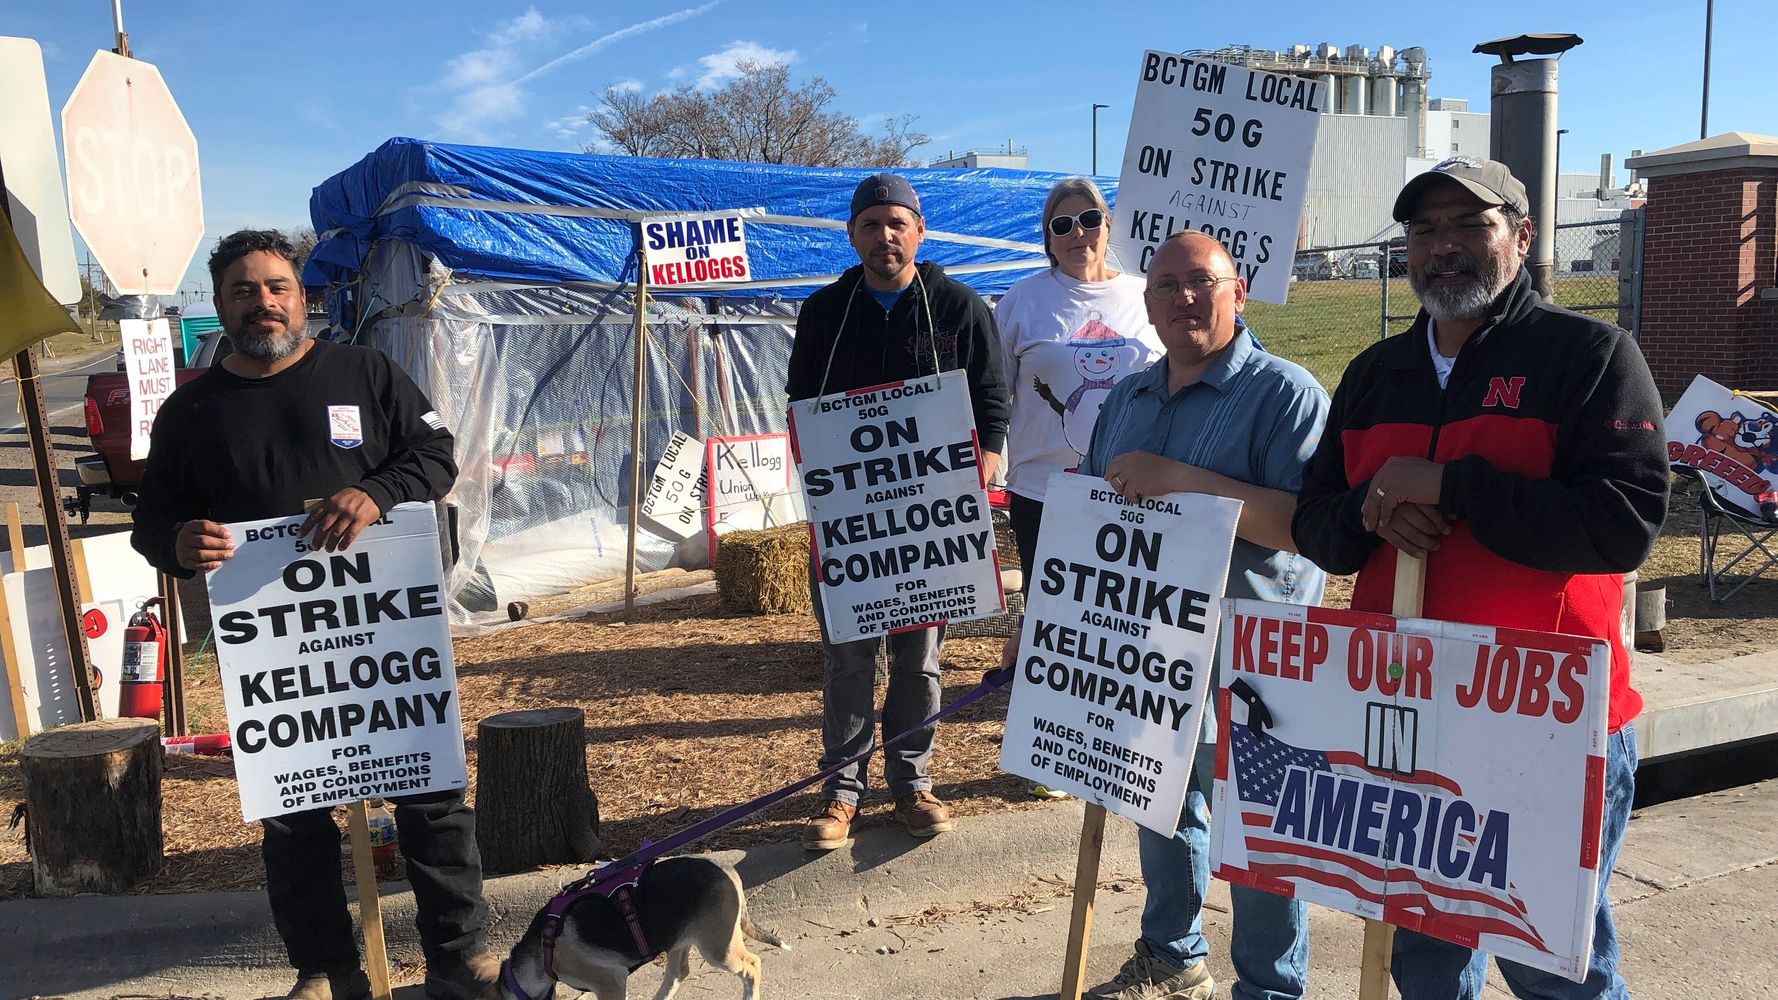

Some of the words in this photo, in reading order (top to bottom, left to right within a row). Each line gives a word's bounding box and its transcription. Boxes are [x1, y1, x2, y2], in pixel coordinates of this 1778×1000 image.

[1144, 52, 1226, 94] BCTGM
[1246, 72, 1318, 112] LOCAL
[75, 126, 189, 221] STOP
[1138, 146, 1172, 178] ON
[1190, 156, 1286, 201] STRIKE
[1169, 190, 1256, 220] AGAINST
[646, 218, 740, 250] SHAME
[686, 246, 710, 260] ON
[652, 256, 746, 285] KELLOGGS
[132, 338, 167, 355] RIGHT
[138, 357, 170, 375] LANE
[140, 377, 170, 395] MUST
[821, 393, 877, 413] BCTGM
[882, 382, 934, 401] LOCAL
[1482, 377, 1526, 408] N
[858, 406, 889, 420] 50G
[850, 416, 920, 453] ON
[716, 441, 782, 470] Kellogg
[804, 440, 978, 497] STRIKE
[643, 474, 666, 517] BCTGM
[660, 433, 688, 470] LOCAL
[720, 480, 754, 494] Union
[865, 484, 924, 504] AGAINST
[1138, 496, 1182, 516] LOCAL
[678, 506, 695, 524] ON
[822, 494, 980, 548] KELLOGG
[1120, 510, 1144, 524] 50G
[246, 524, 300, 542] BCTG
[1096, 523, 1162, 572] ON
[282, 552, 372, 592] ON
[822, 530, 989, 587] COMPANY
[852, 598, 905, 614] WAGES,
[910, 584, 976, 603] BENEFITS
[896, 579, 928, 592] FOR
[1040, 558, 1210, 634] STRIKE
[218, 584, 442, 644] STRIKE
[856, 612, 885, 624] AND
[890, 596, 976, 618] CONDITIONS
[859, 623, 877, 634] OF
[882, 606, 976, 630] EMPLOYMENT
[1080, 610, 1151, 639] AGAINST
[298, 632, 375, 654] AGAINST
[1032, 620, 1194, 691] KELLOGG
[240, 647, 442, 707] KELLOGG
[1232, 614, 1328, 682] KEEP
[1347, 628, 1434, 700] OUR
[1456, 644, 1588, 724] JOBS
[1025, 656, 1192, 732] COMPANY
[236, 691, 452, 754] COMPANY
[1086, 712, 1114, 732] FOR
[332, 744, 371, 760] FOR
[1033, 716, 1088, 749] WAGES,
[1092, 737, 1163, 774] BENEFITS
[1364, 702, 1418, 776] IN
[274, 765, 344, 784] WAGES,
[349, 752, 431, 772] BENEFITS
[1032, 736, 1064, 756] AND
[1068, 748, 1156, 793] CONDITIONS
[280, 781, 316, 796] AND
[322, 765, 431, 788] CONDITIONS
[282, 796, 305, 808] OF
[312, 776, 431, 804] EMPLOYMENT
[1031, 754, 1050, 768] OF
[1054, 762, 1152, 810] EMPLOYMENT
[1272, 768, 1510, 890] AMERICA
